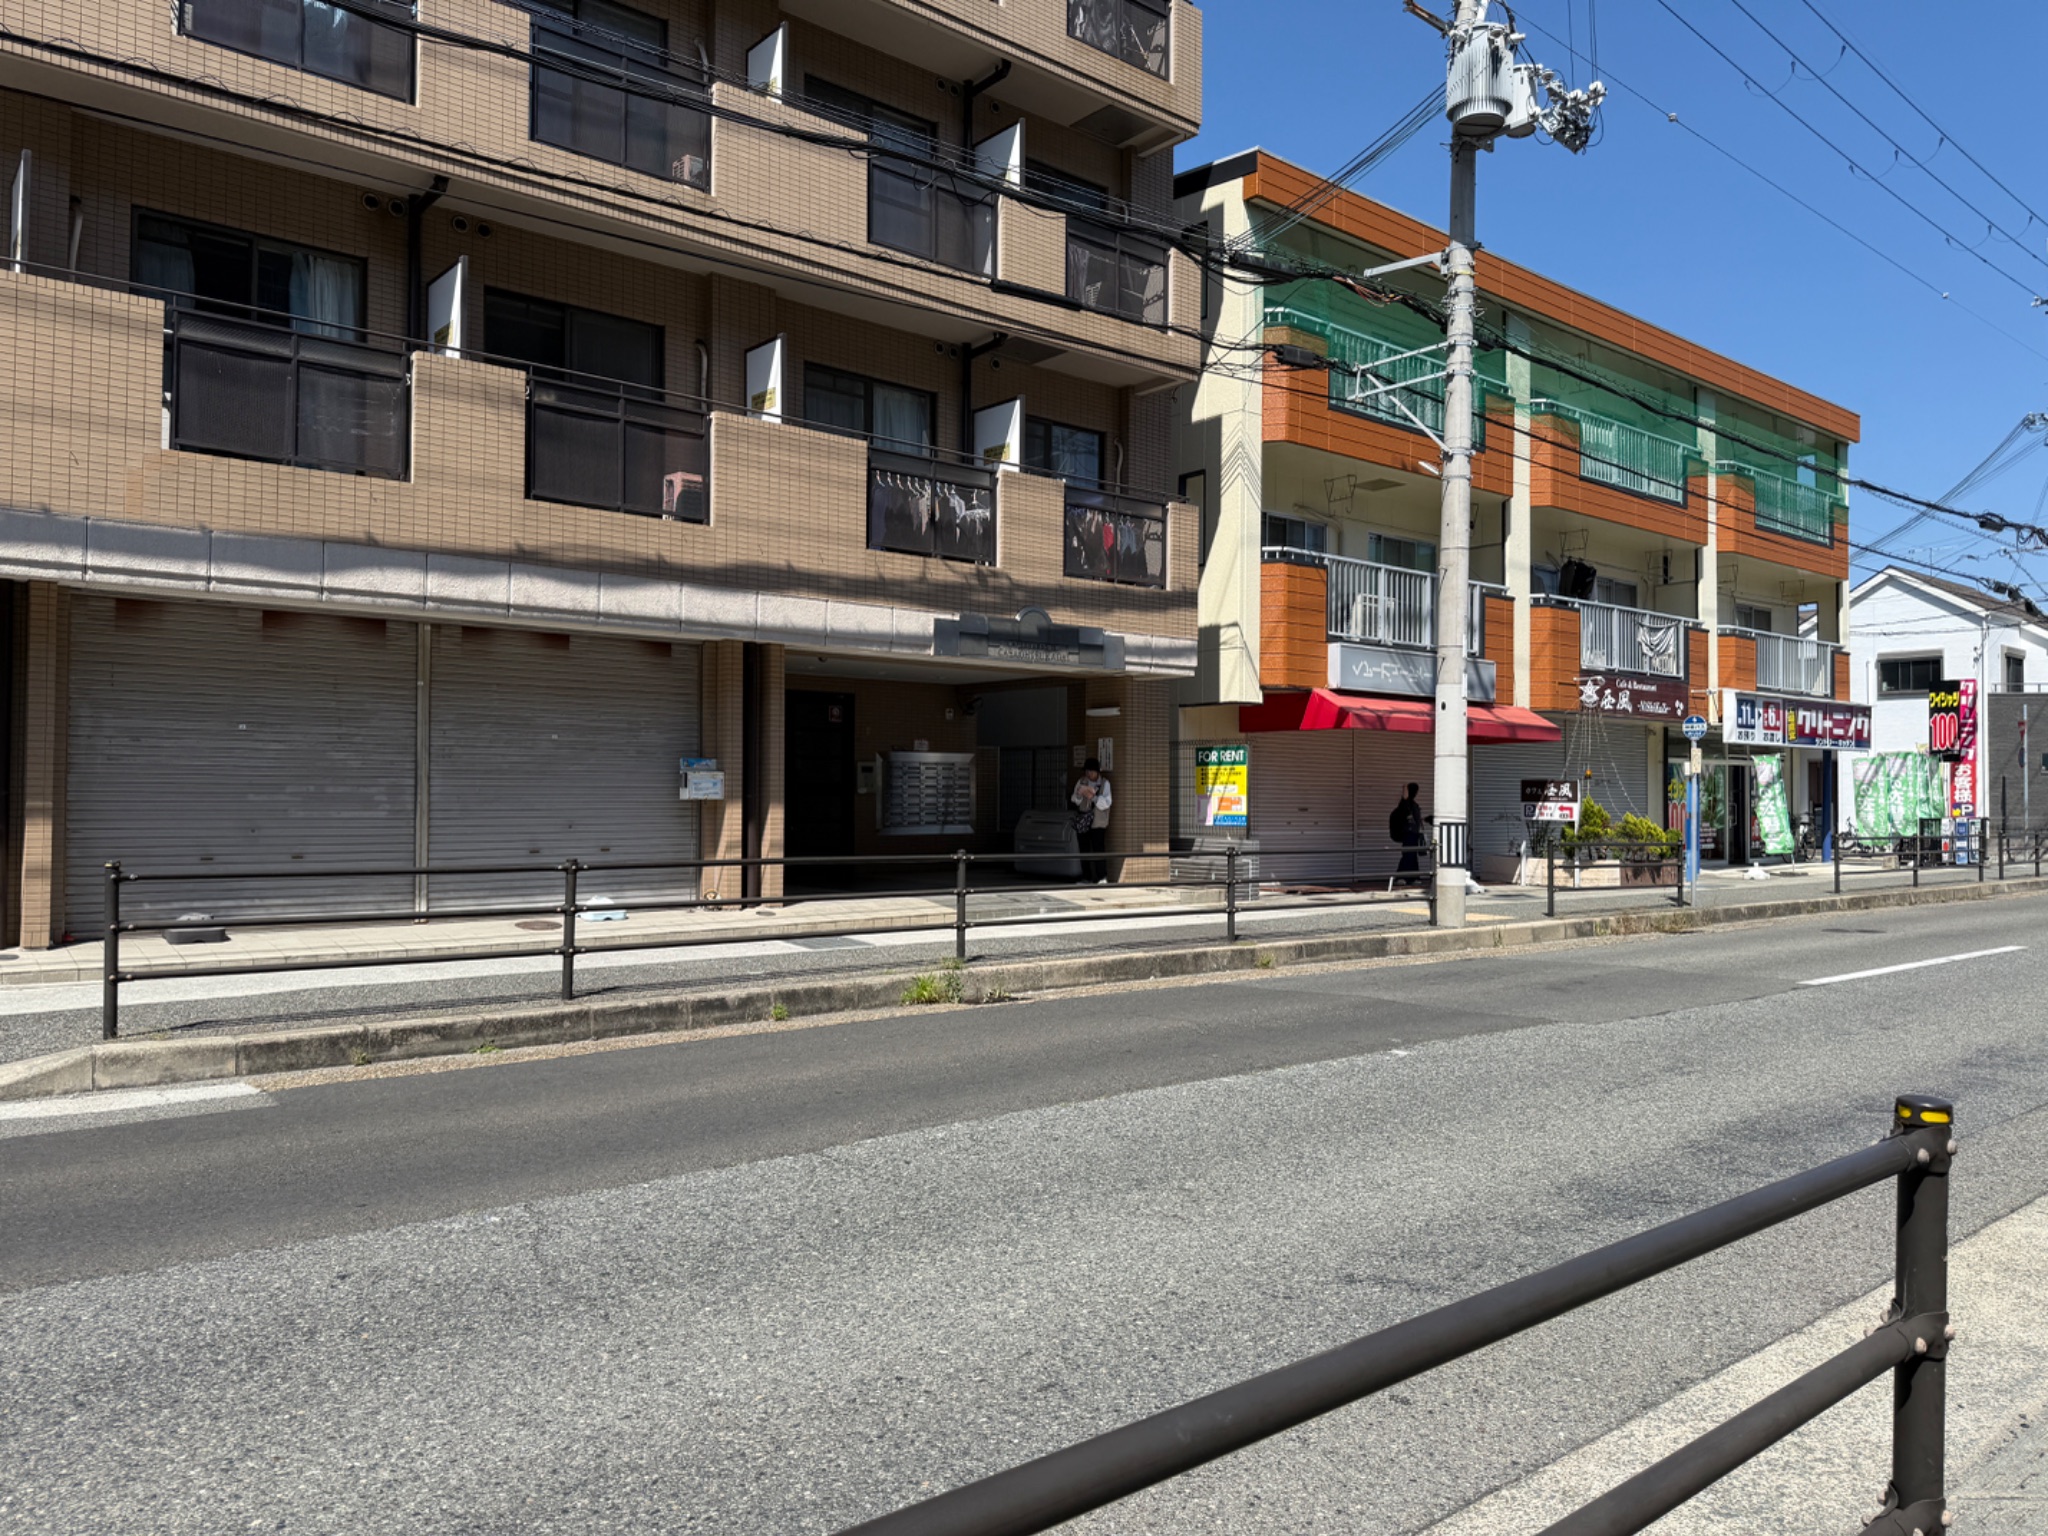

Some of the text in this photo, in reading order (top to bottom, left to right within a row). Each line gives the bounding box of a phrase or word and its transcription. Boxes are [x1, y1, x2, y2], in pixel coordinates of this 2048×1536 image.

[1797, 707, 1871, 738] クリーニング
[1960, 681, 1975, 760] クリーニング
[1198, 749, 1245, 762] FOR RENT
